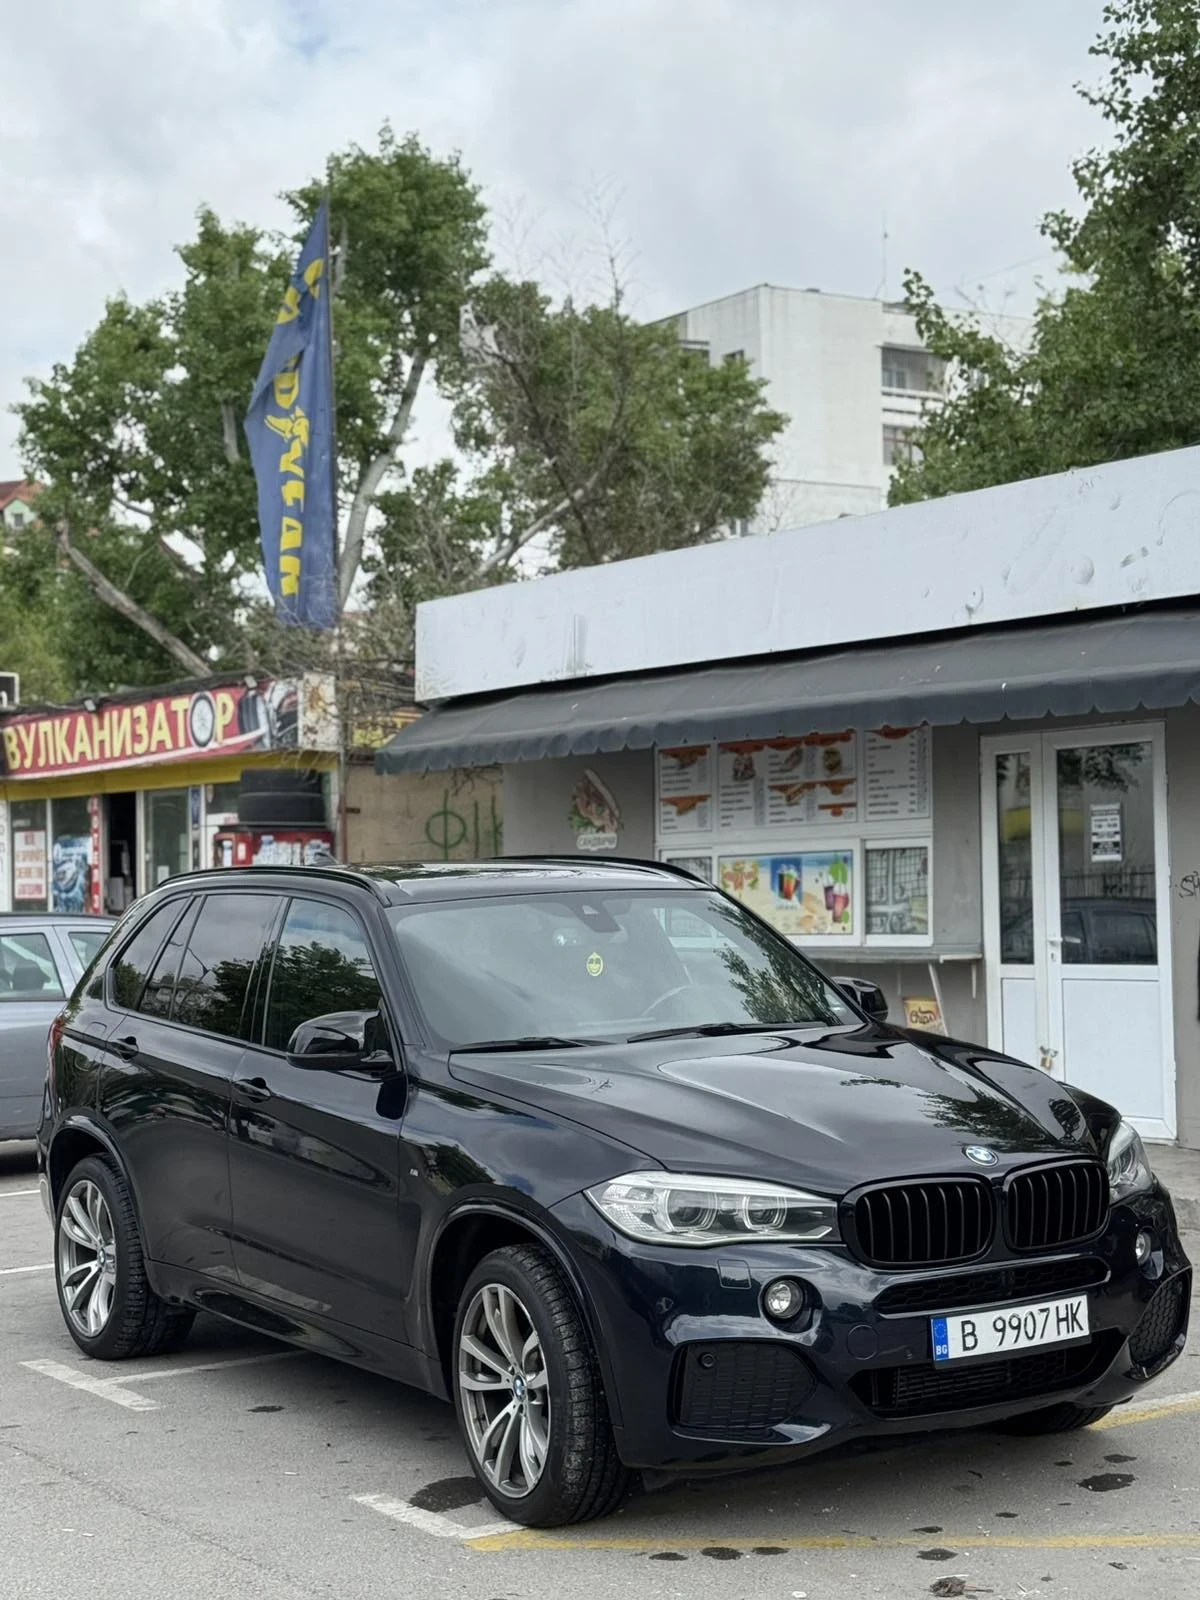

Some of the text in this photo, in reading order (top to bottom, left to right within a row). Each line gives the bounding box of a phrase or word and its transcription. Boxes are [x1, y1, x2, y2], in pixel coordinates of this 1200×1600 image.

[2, 692, 235, 771] ВУЛКАНИЗАТОР
[936, 1344, 948, 1356] BG
[960, 1319, 979, 1352] B
